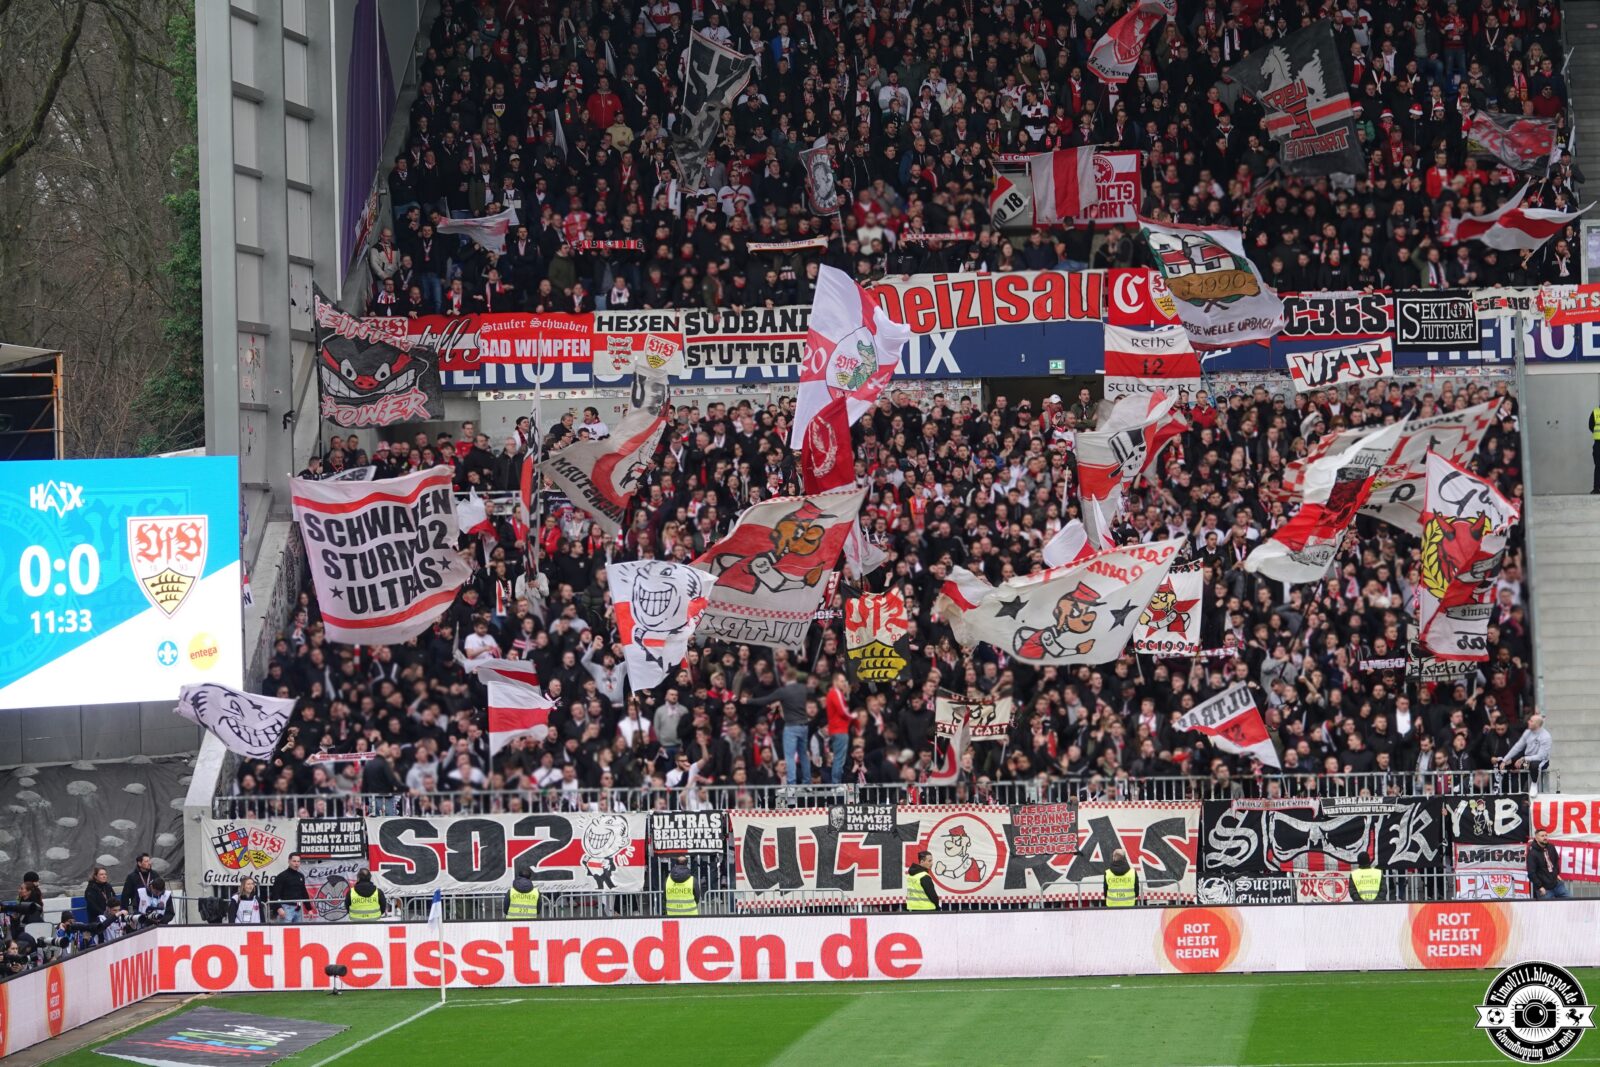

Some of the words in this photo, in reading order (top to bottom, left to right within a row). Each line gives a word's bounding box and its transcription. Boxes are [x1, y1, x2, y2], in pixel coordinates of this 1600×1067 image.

[1003, 192, 1024, 213] 18
[597, 315, 679, 332] HESSEN
[1203, 324, 1235, 336] WELLE
[480, 339, 510, 357] BAD
[515, 338, 591, 357] WIMPFEN
[687, 342, 806, 366] STUTTGA
[19, 544, 100, 597] 0:0
[30, 609, 92, 634] 11:33
[189, 645, 218, 660] entega
[847, 806, 865, 814] DU
[867, 805, 893, 814] BIST
[653, 813, 721, 829] ULTRAS
[847, 814, 893, 823] IMMER
[1013, 811, 1076, 827] VERBANNTE
[301, 821, 337, 833] KAMPF
[339, 821, 361, 832] UND
[847, 823, 865, 831] BEI
[301, 834, 342, 844] EINSATZ
[344, 832, 361, 843] FÜR
[653, 828, 722, 840] BEDEUTET
[301, 845, 328, 853] UNSERE
[654, 839, 723, 849] WIDERSTAND
[667, 887, 692, 895] ORDNER
[1437, 912, 1471, 926] ROT
[1184, 923, 1211, 934] ROT
[1175, 947, 1220, 959] REDEN
[1427, 943, 1482, 957] REDEN
